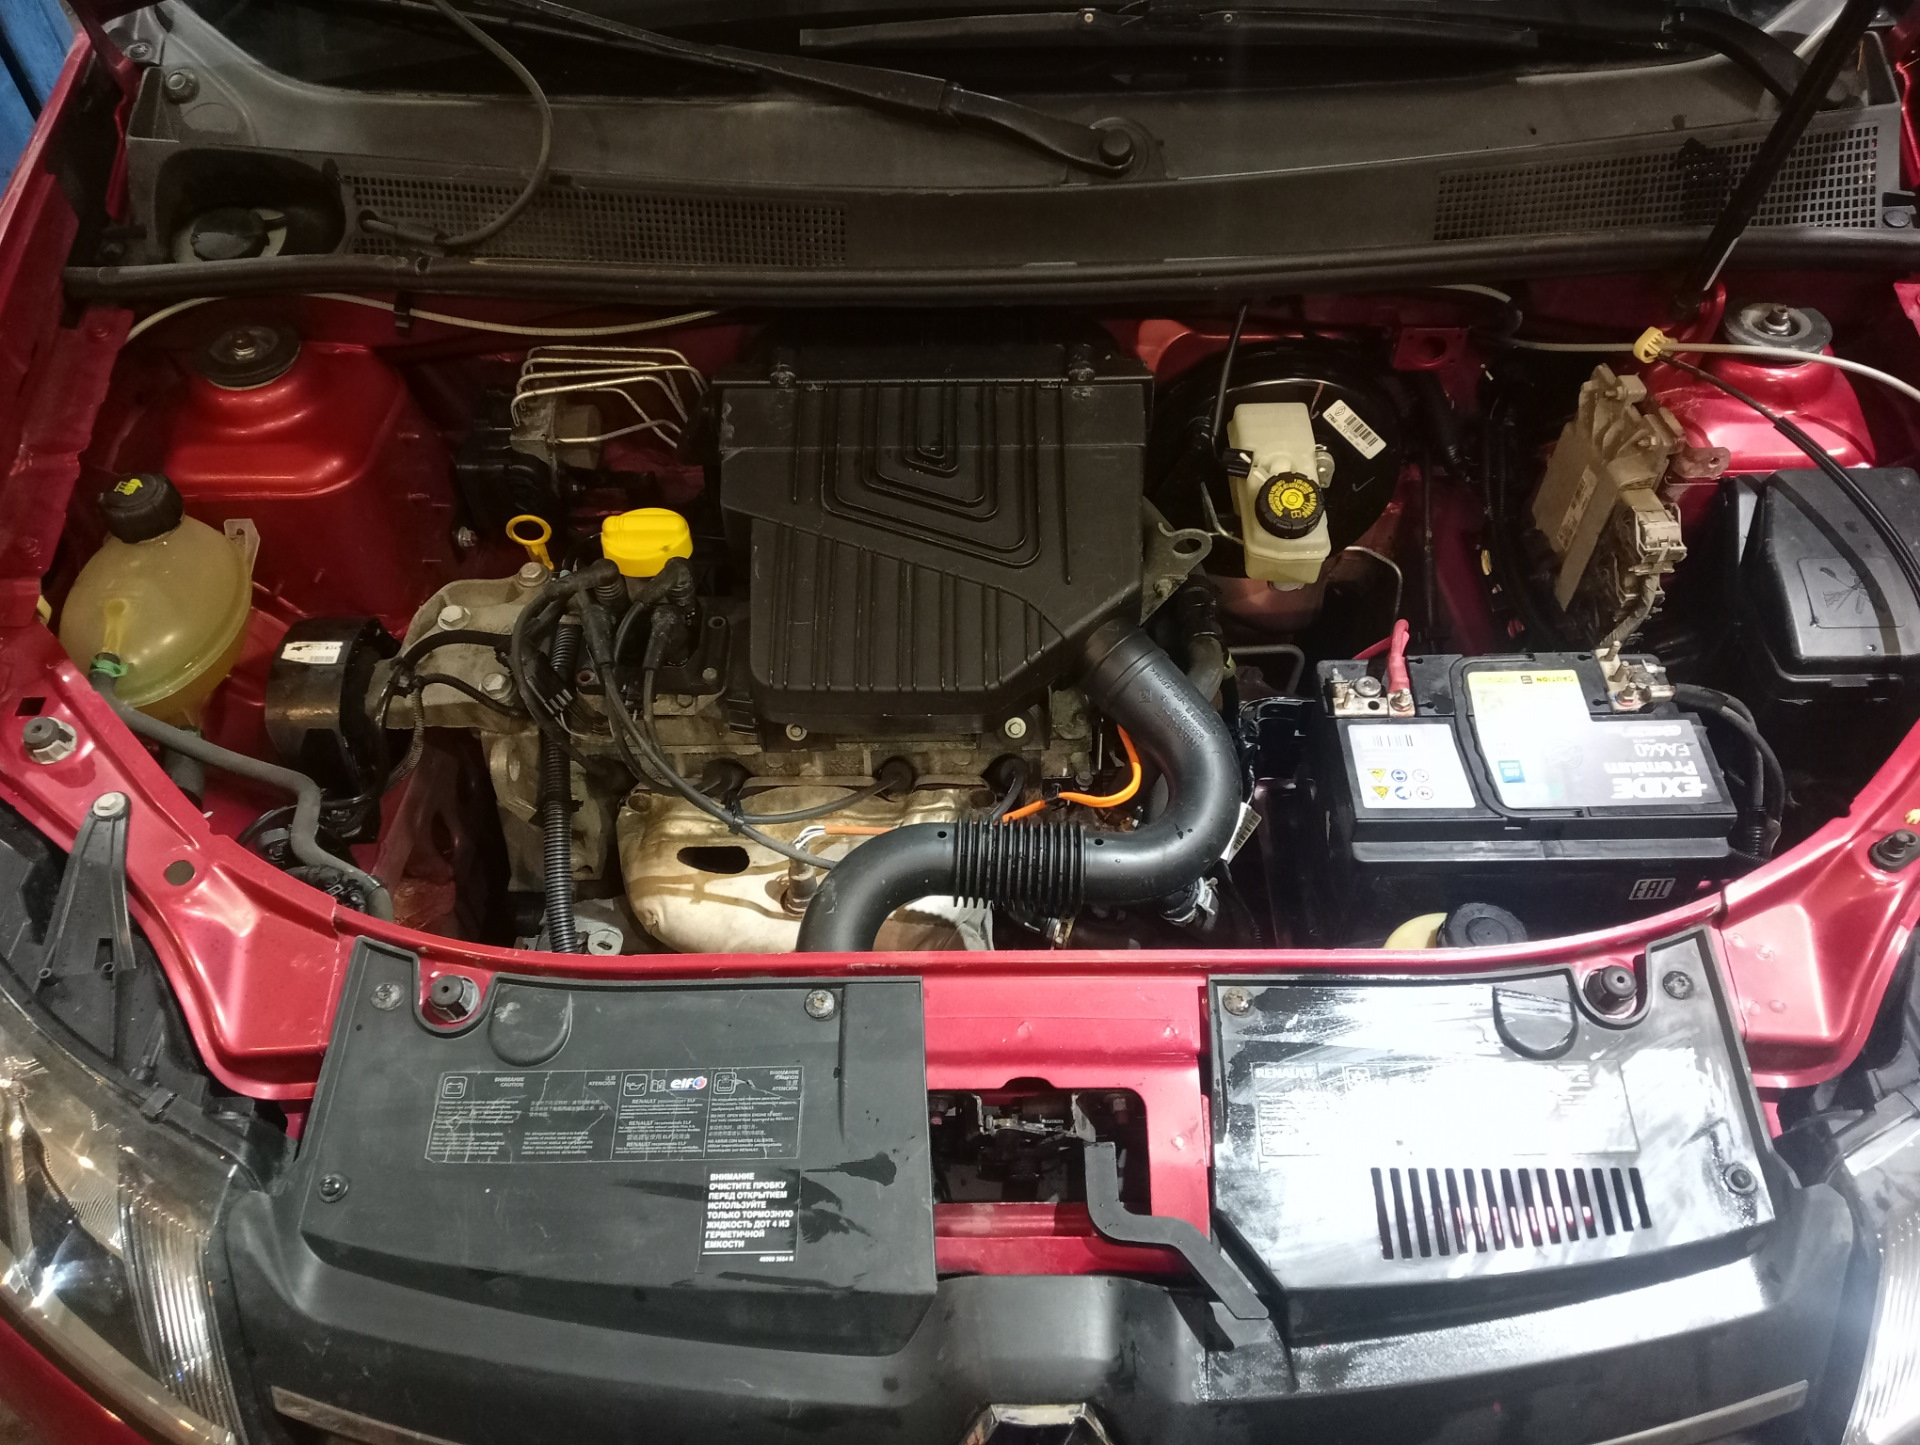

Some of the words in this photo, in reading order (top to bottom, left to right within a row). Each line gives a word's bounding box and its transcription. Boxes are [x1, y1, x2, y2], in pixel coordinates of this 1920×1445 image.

[1603, 760, 1698, 776] Premium
[1610, 775, 1707, 799] EXIDE
[1631, 879, 1673, 898] EAC
[670, 1077, 694, 1089] elf
[710, 1173, 755, 1181] ВНИМАНИЕ
[709, 1182, 752, 1191] ОЧИСТИТЕ
[752, 1181, 787, 1190] ПРОБКУ
[708, 1191, 736, 1201] ПЕРЕД
[736, 1190, 788, 1200] ОТКРЫТИЕМ
[707, 1200, 767, 1210] ИСПОЛЬЗУЙТЕ
[707, 1211, 741, 1220] ТОЛЬКО
[742, 1209, 794, 1219] ТОРМОЗНУЮ
[706, 1220, 753, 1230] ЖИДКОСТЬ
[753, 1220, 772, 1229] ДОТ
[772, 1220, 778, 1229] 4
[778, 1219, 790, 1228] ИЗ
[705, 1229, 765, 1239] ГЕРМЕТИЧНОЙ
[704, 1240, 745, 1249] ЕМКОСТИ
